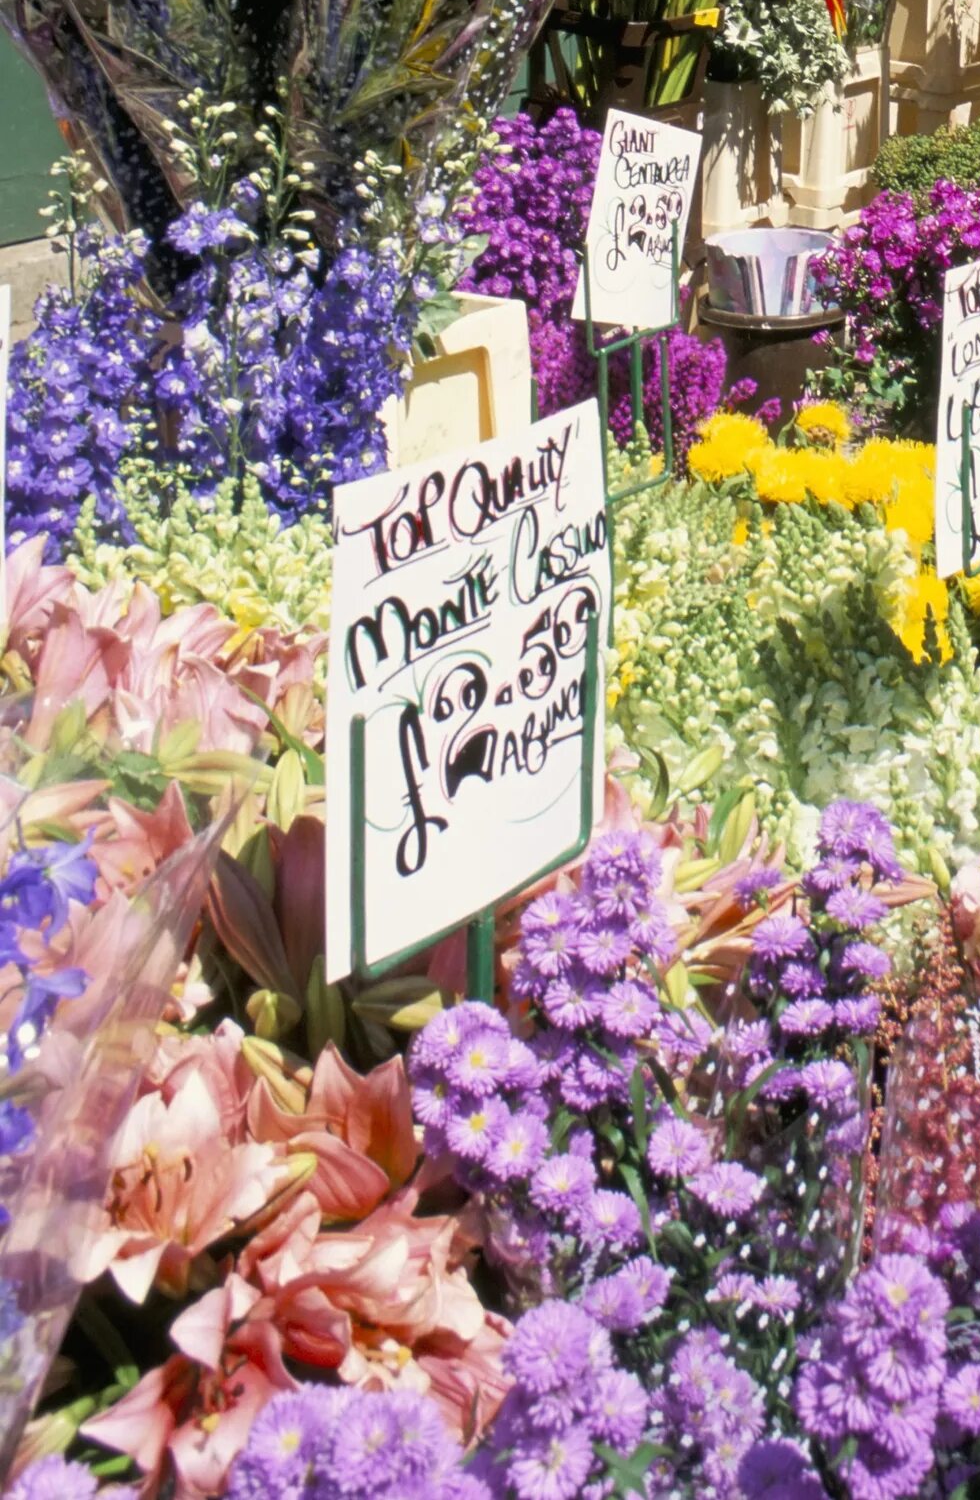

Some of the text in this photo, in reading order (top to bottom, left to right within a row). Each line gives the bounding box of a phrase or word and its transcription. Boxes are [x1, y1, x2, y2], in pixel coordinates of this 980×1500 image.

[610, 120, 658, 158] GIANT
[342, 423, 572, 574] TOP QUALITY
[397, 587, 599, 877] £2.50
